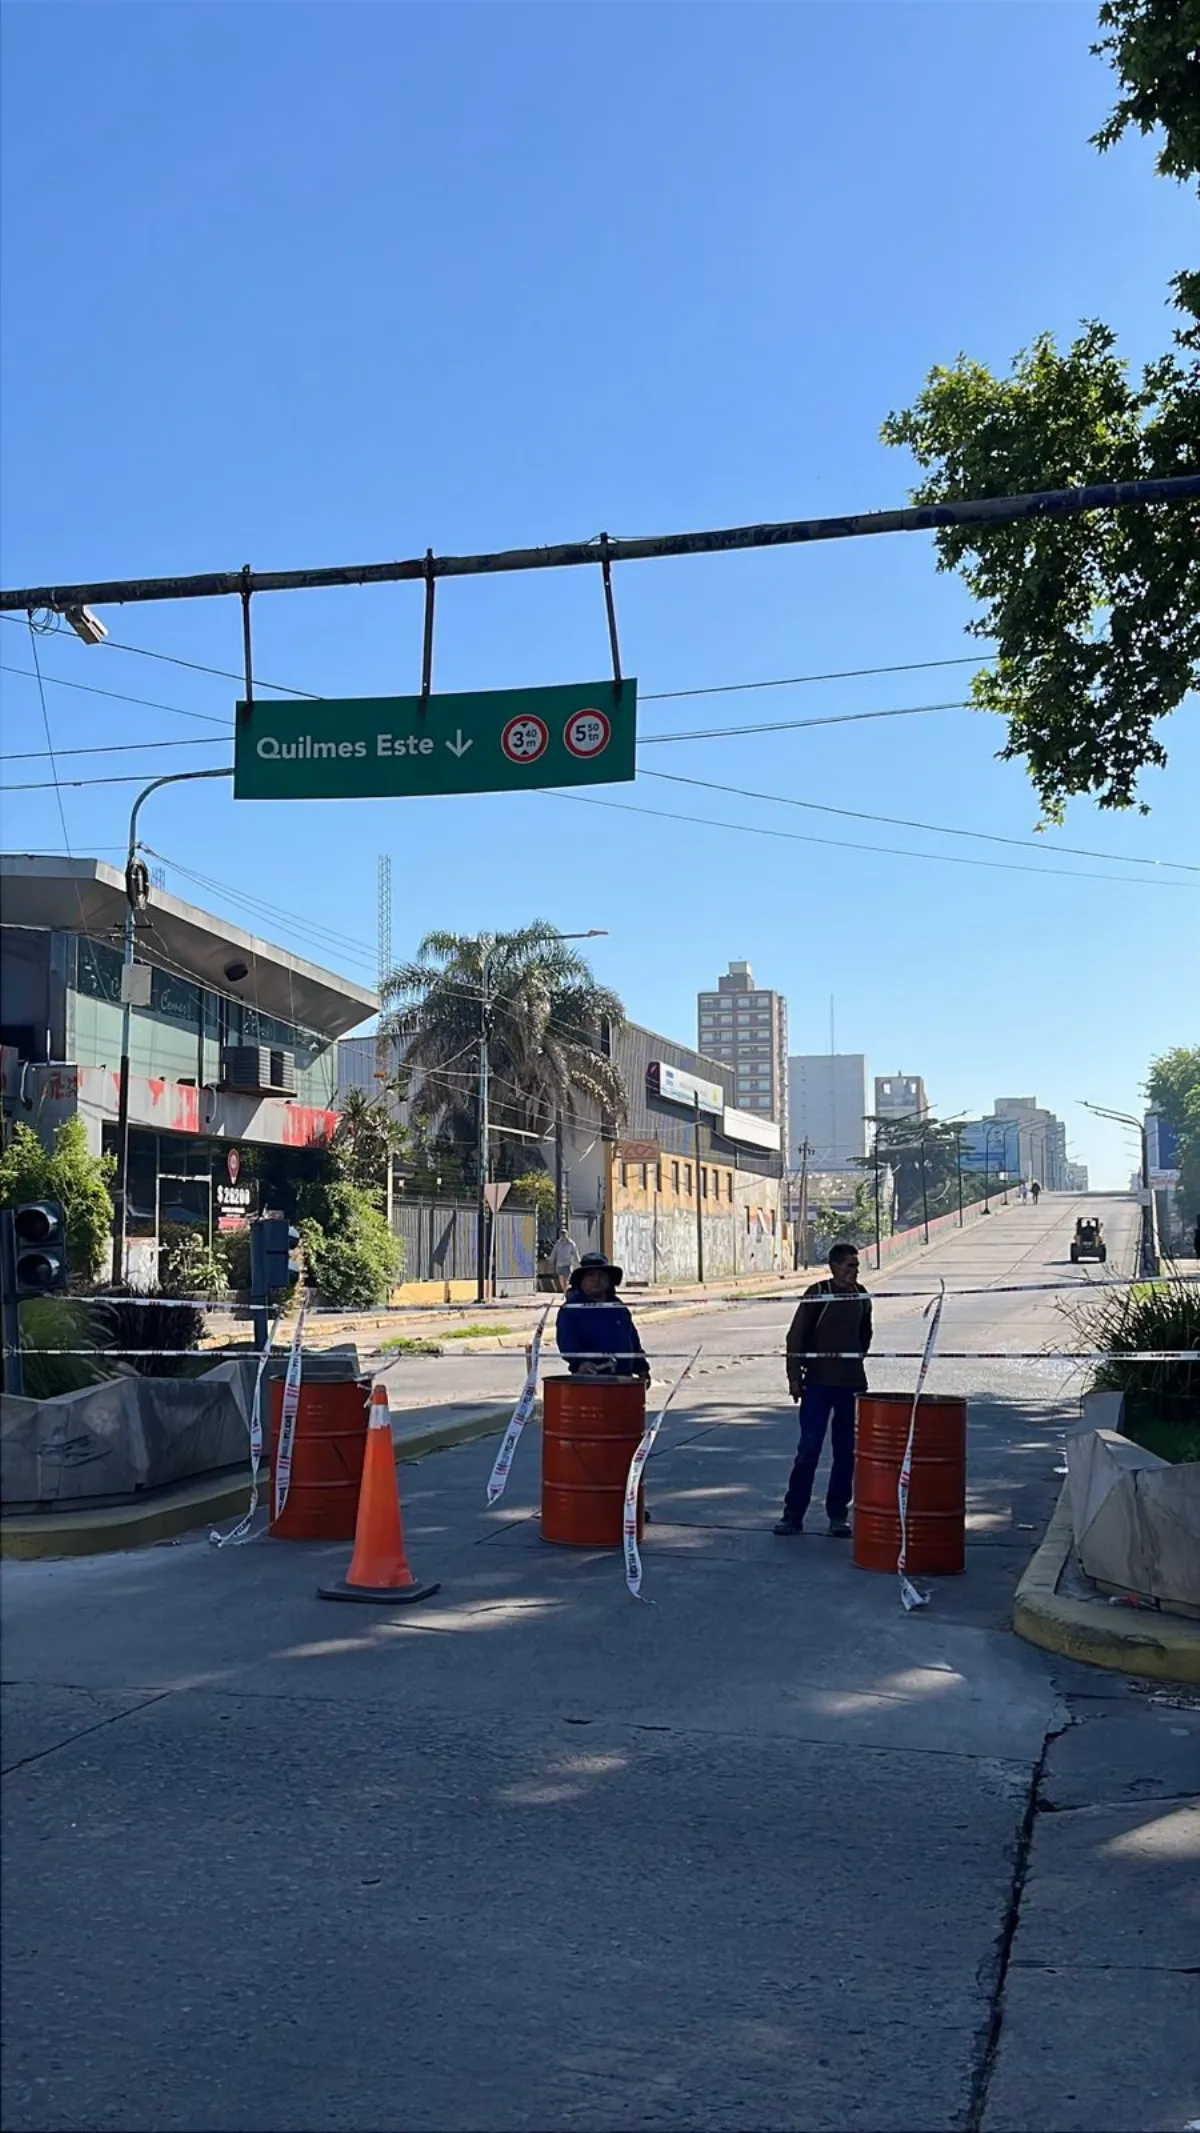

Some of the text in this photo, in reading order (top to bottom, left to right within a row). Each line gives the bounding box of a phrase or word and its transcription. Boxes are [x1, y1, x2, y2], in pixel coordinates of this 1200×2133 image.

[512, 729, 537, 748] 3 40
[575, 723, 600, 742] 5 50
[588, 733, 599, 742] tn
[257, 734, 434, 759] Quilmes Este
[526, 739, 536, 748] m
